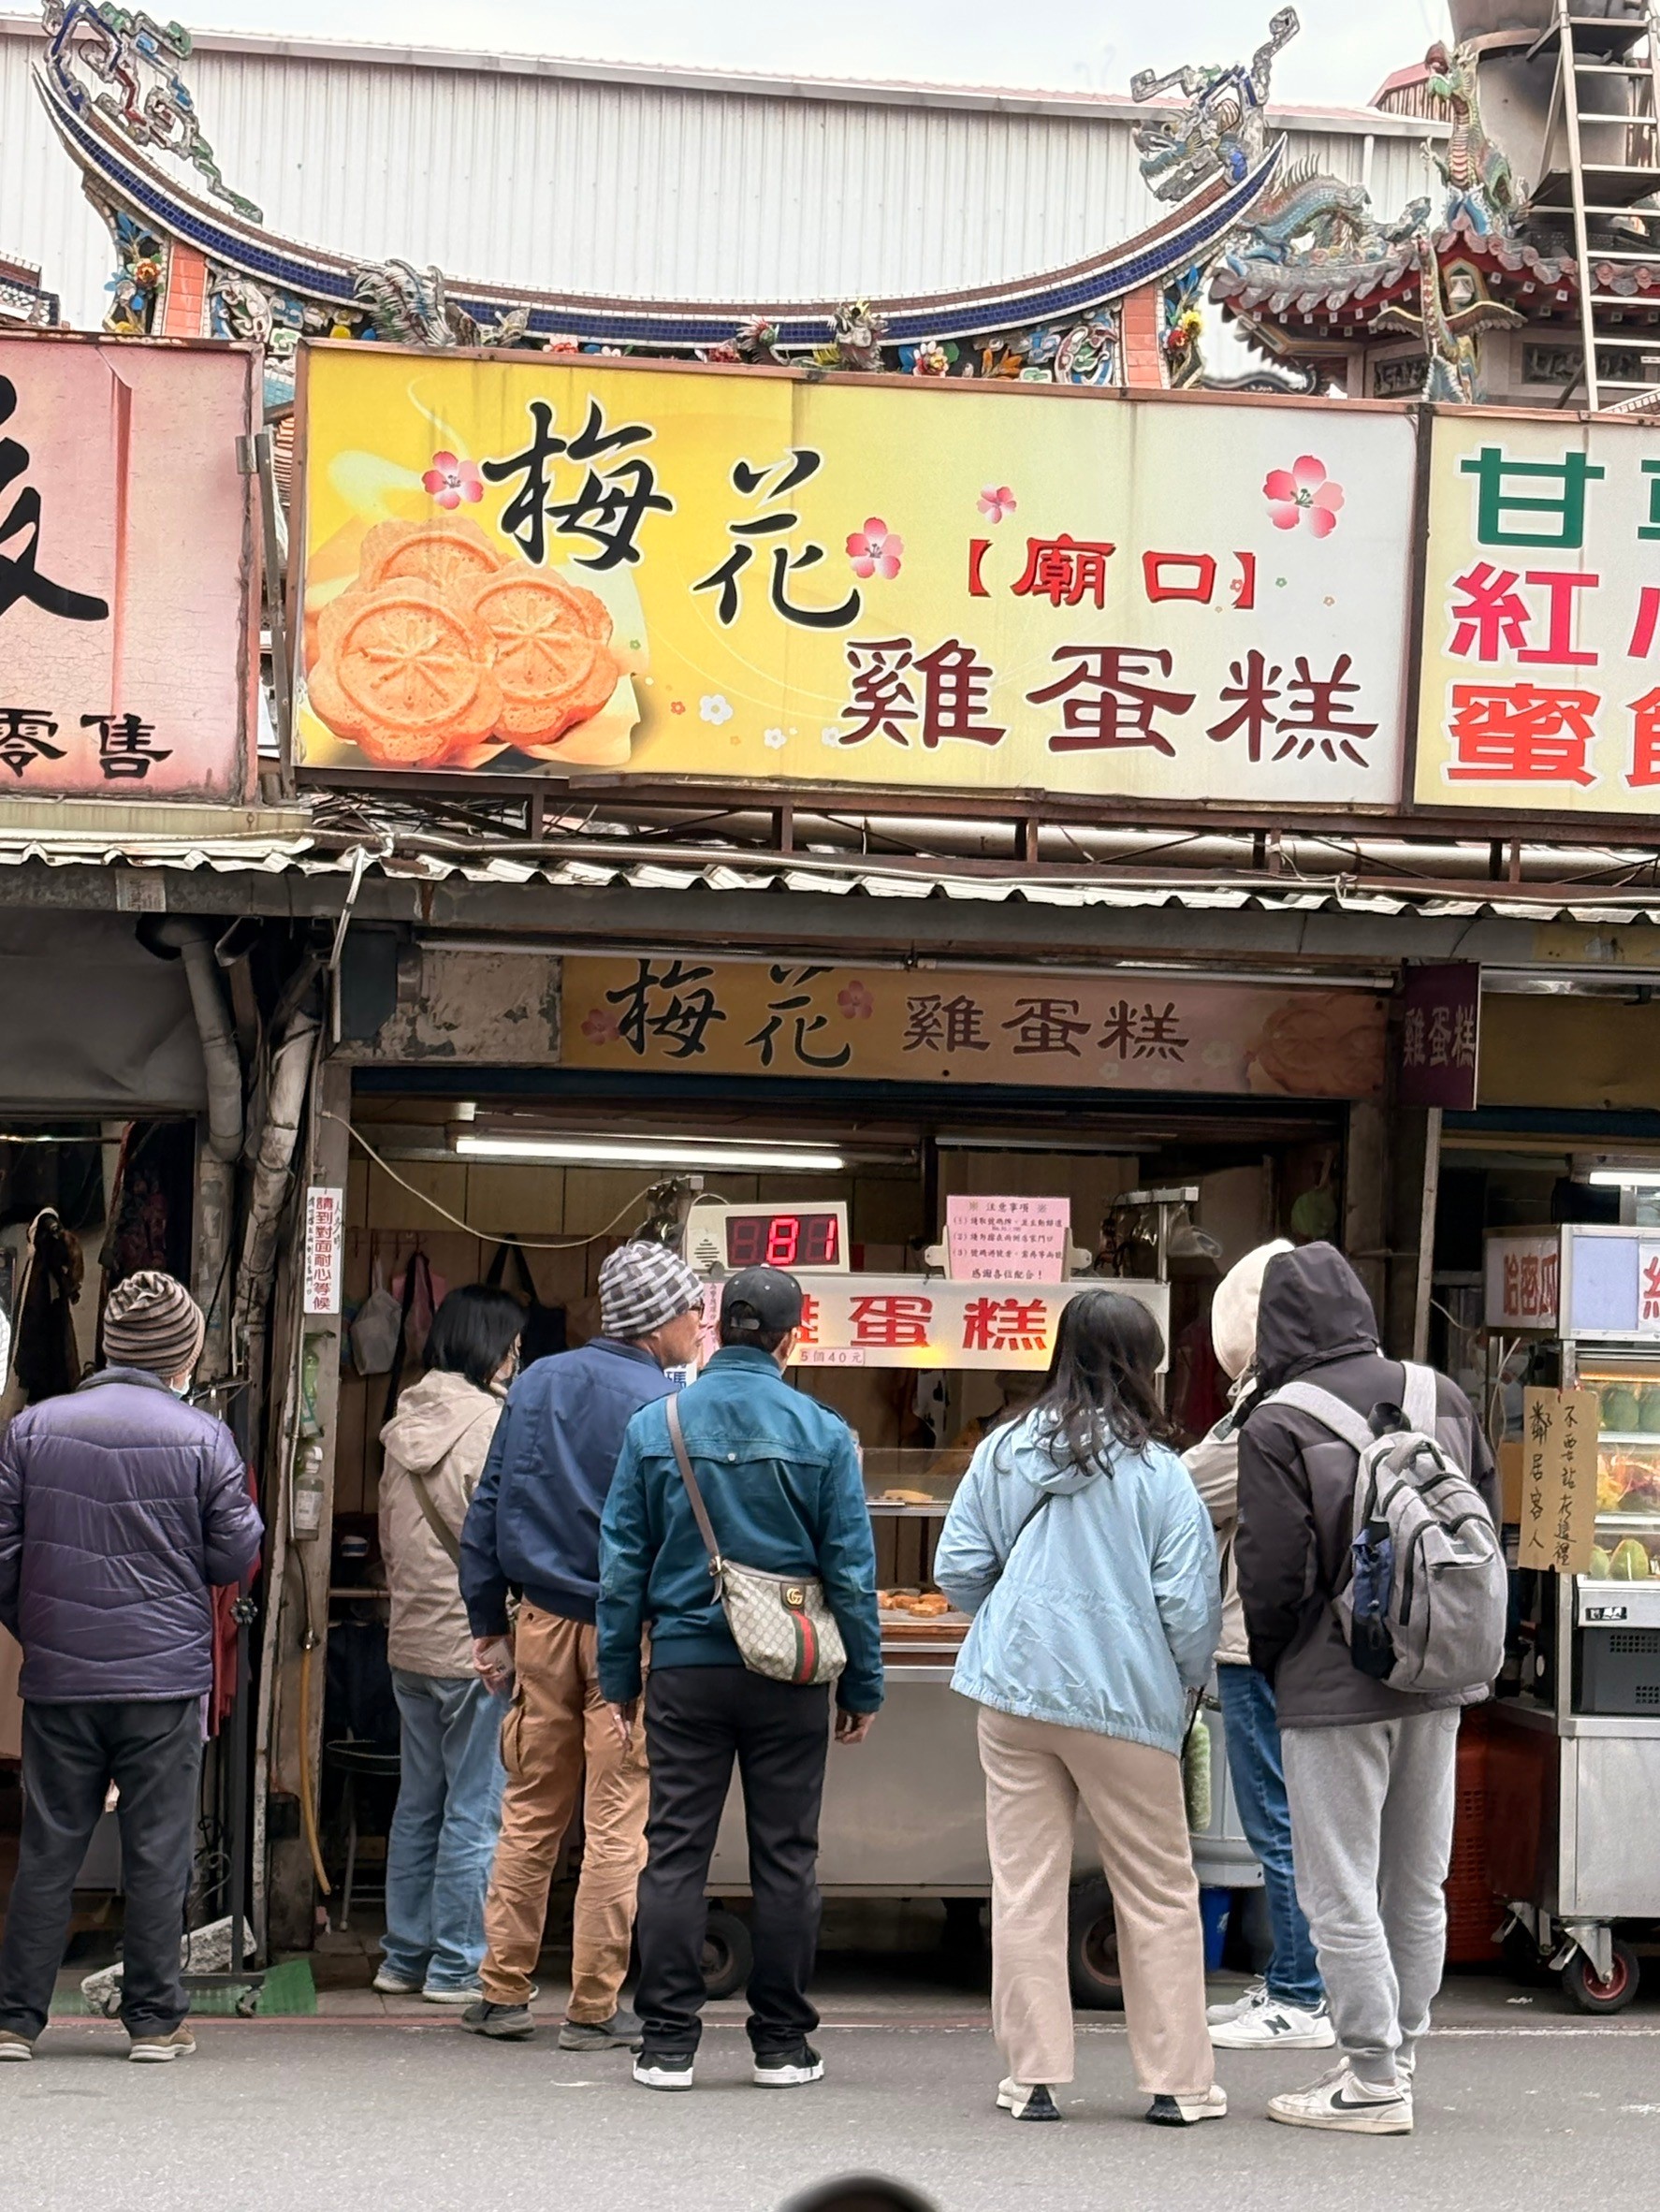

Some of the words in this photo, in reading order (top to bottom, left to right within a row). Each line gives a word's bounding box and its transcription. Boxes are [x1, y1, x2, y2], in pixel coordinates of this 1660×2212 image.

[483, 397, 861, 628] 梅花
[1449, 561, 1660, 665] 紅
[0, 708, 173, 779] 零售
[838, 637, 1378, 769] 雞蛋糕
[606, 958, 851, 1069] 梅花
[902, 994, 1189, 1063] 雞蛋糕
[1404, 1004, 1476, 1069] 雞蛋糕
[313, 1197, 333, 1310] 請到對面耐心等候
[766, 1217, 837, 1265] 81
